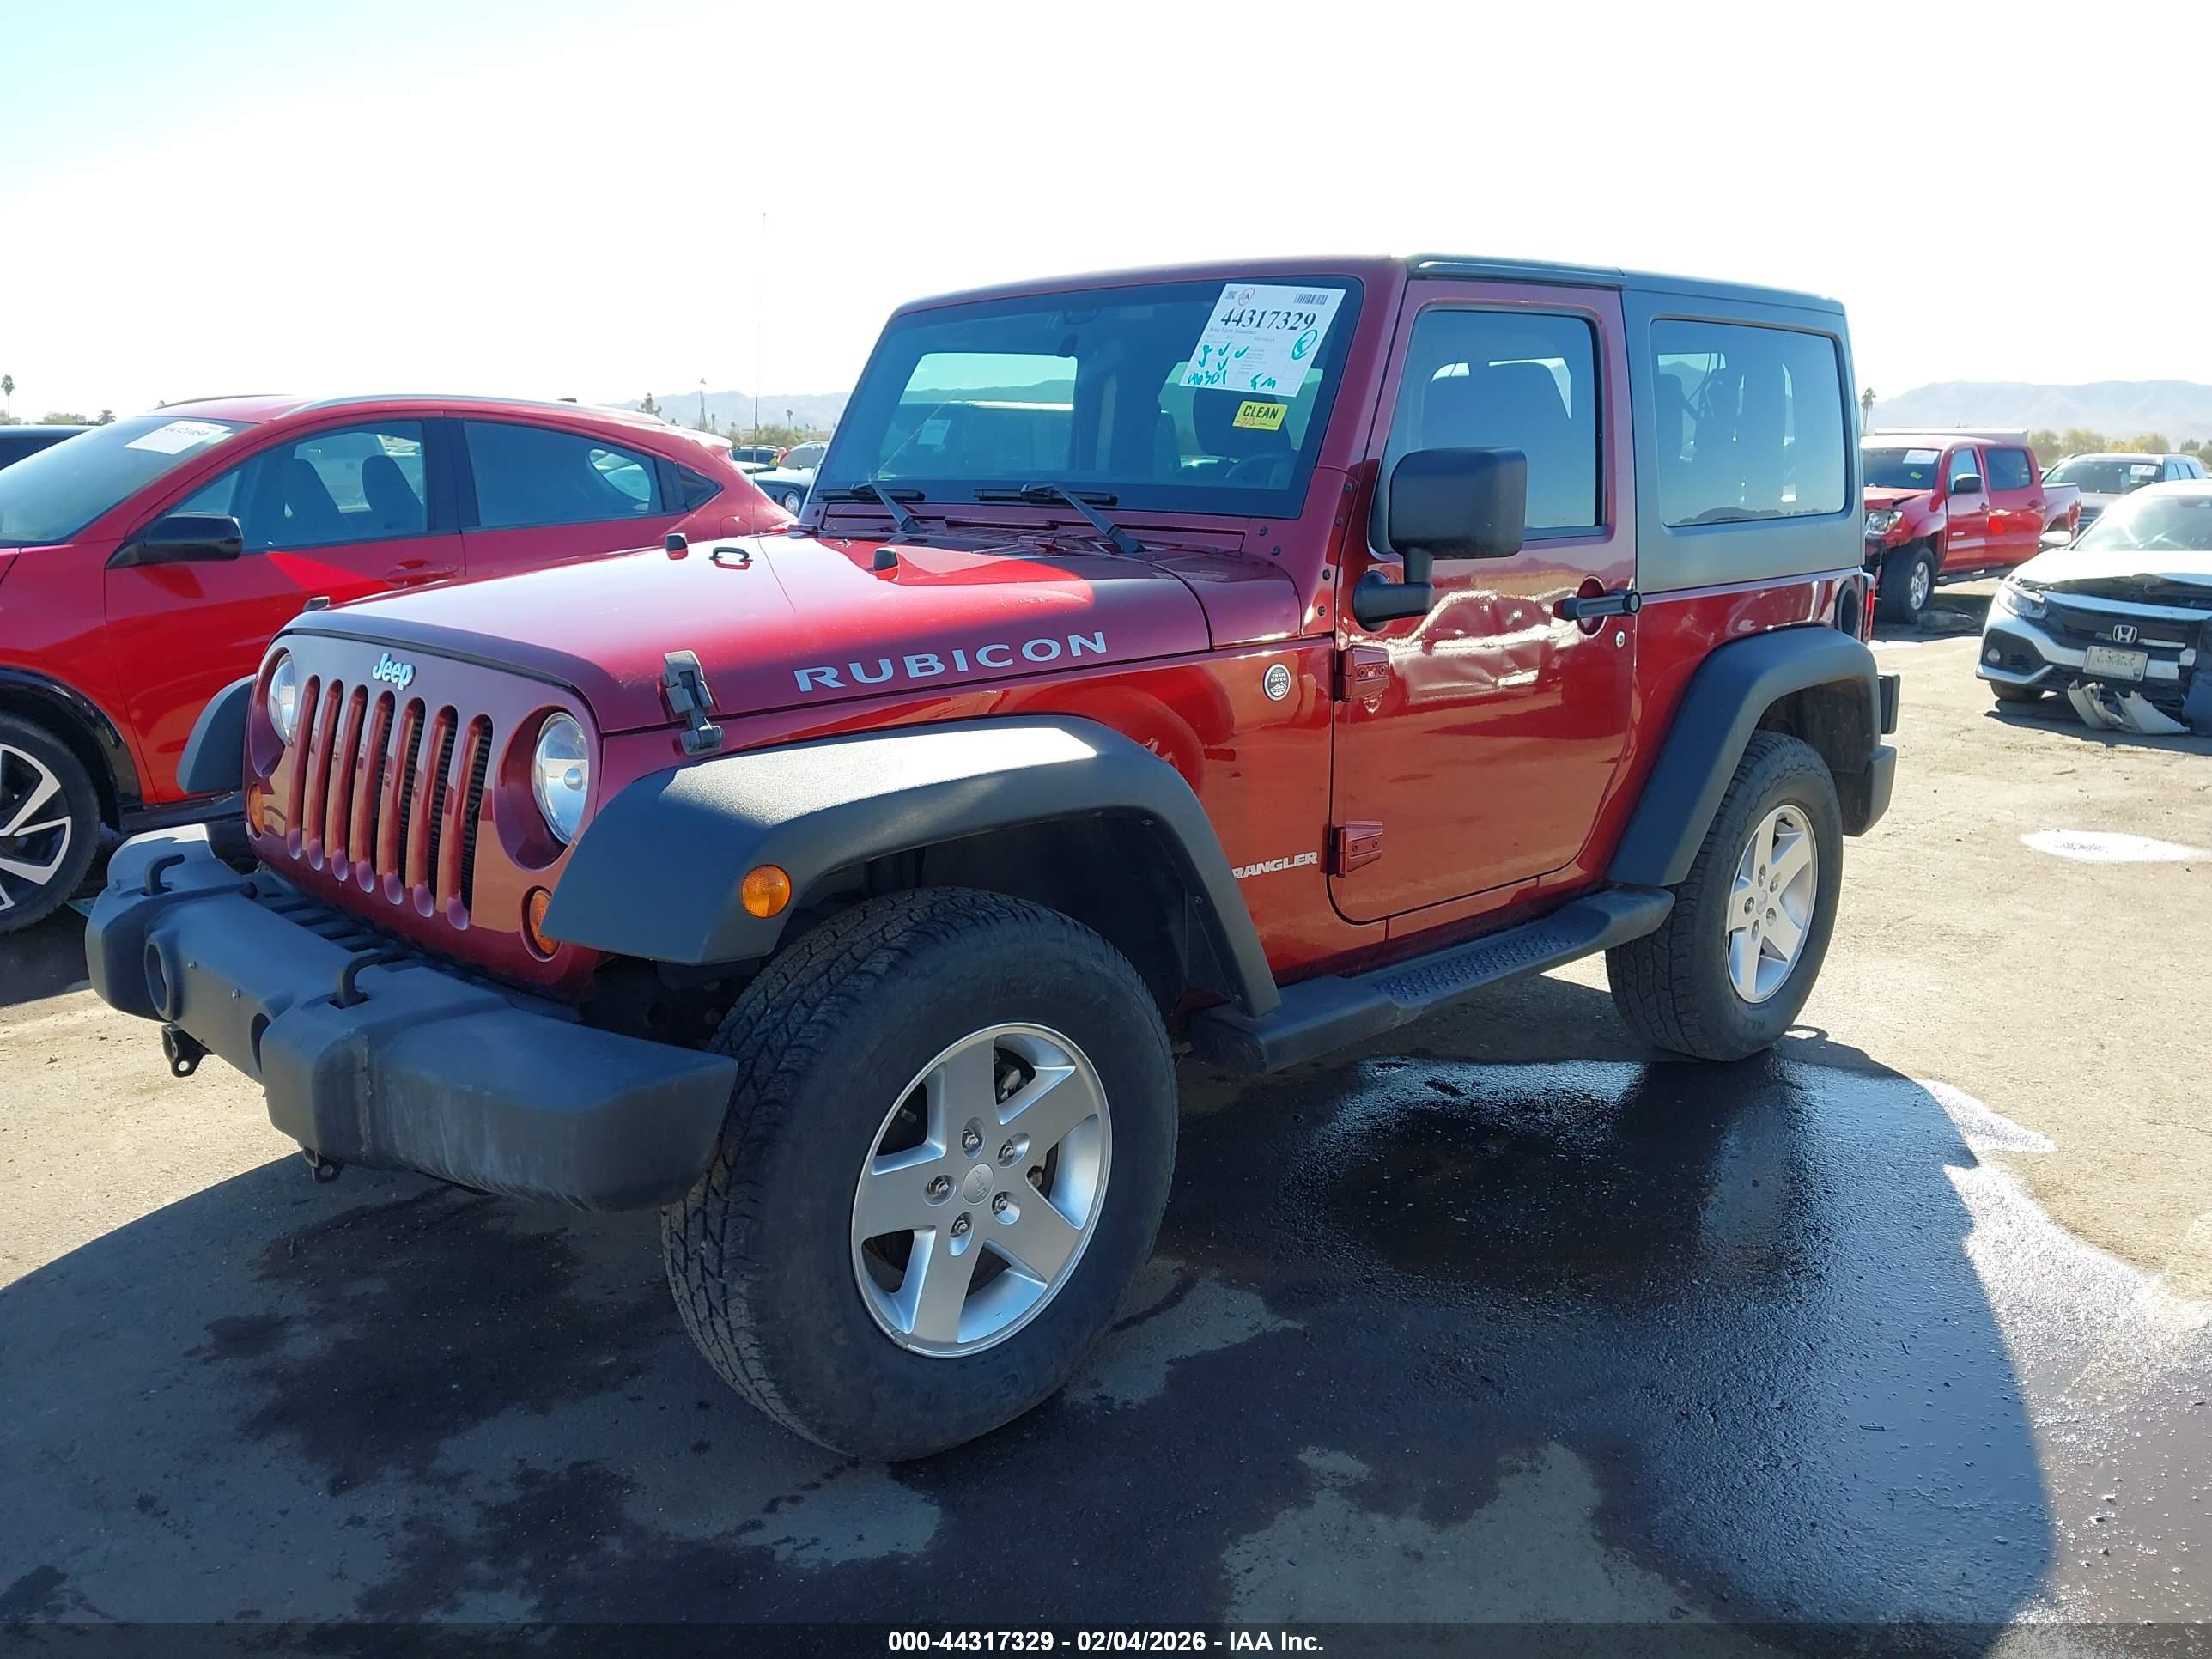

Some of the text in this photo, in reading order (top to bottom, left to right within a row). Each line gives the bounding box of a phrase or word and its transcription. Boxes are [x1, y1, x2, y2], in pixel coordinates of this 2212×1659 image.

[1220, 308, 1316, 331] 44317329
[1243, 404, 1279, 420] CLEAN
[372, 653, 414, 691] Jeep
[793, 631, 1108, 692] RUBICON
[1231, 851, 1319, 879] RANGLER
